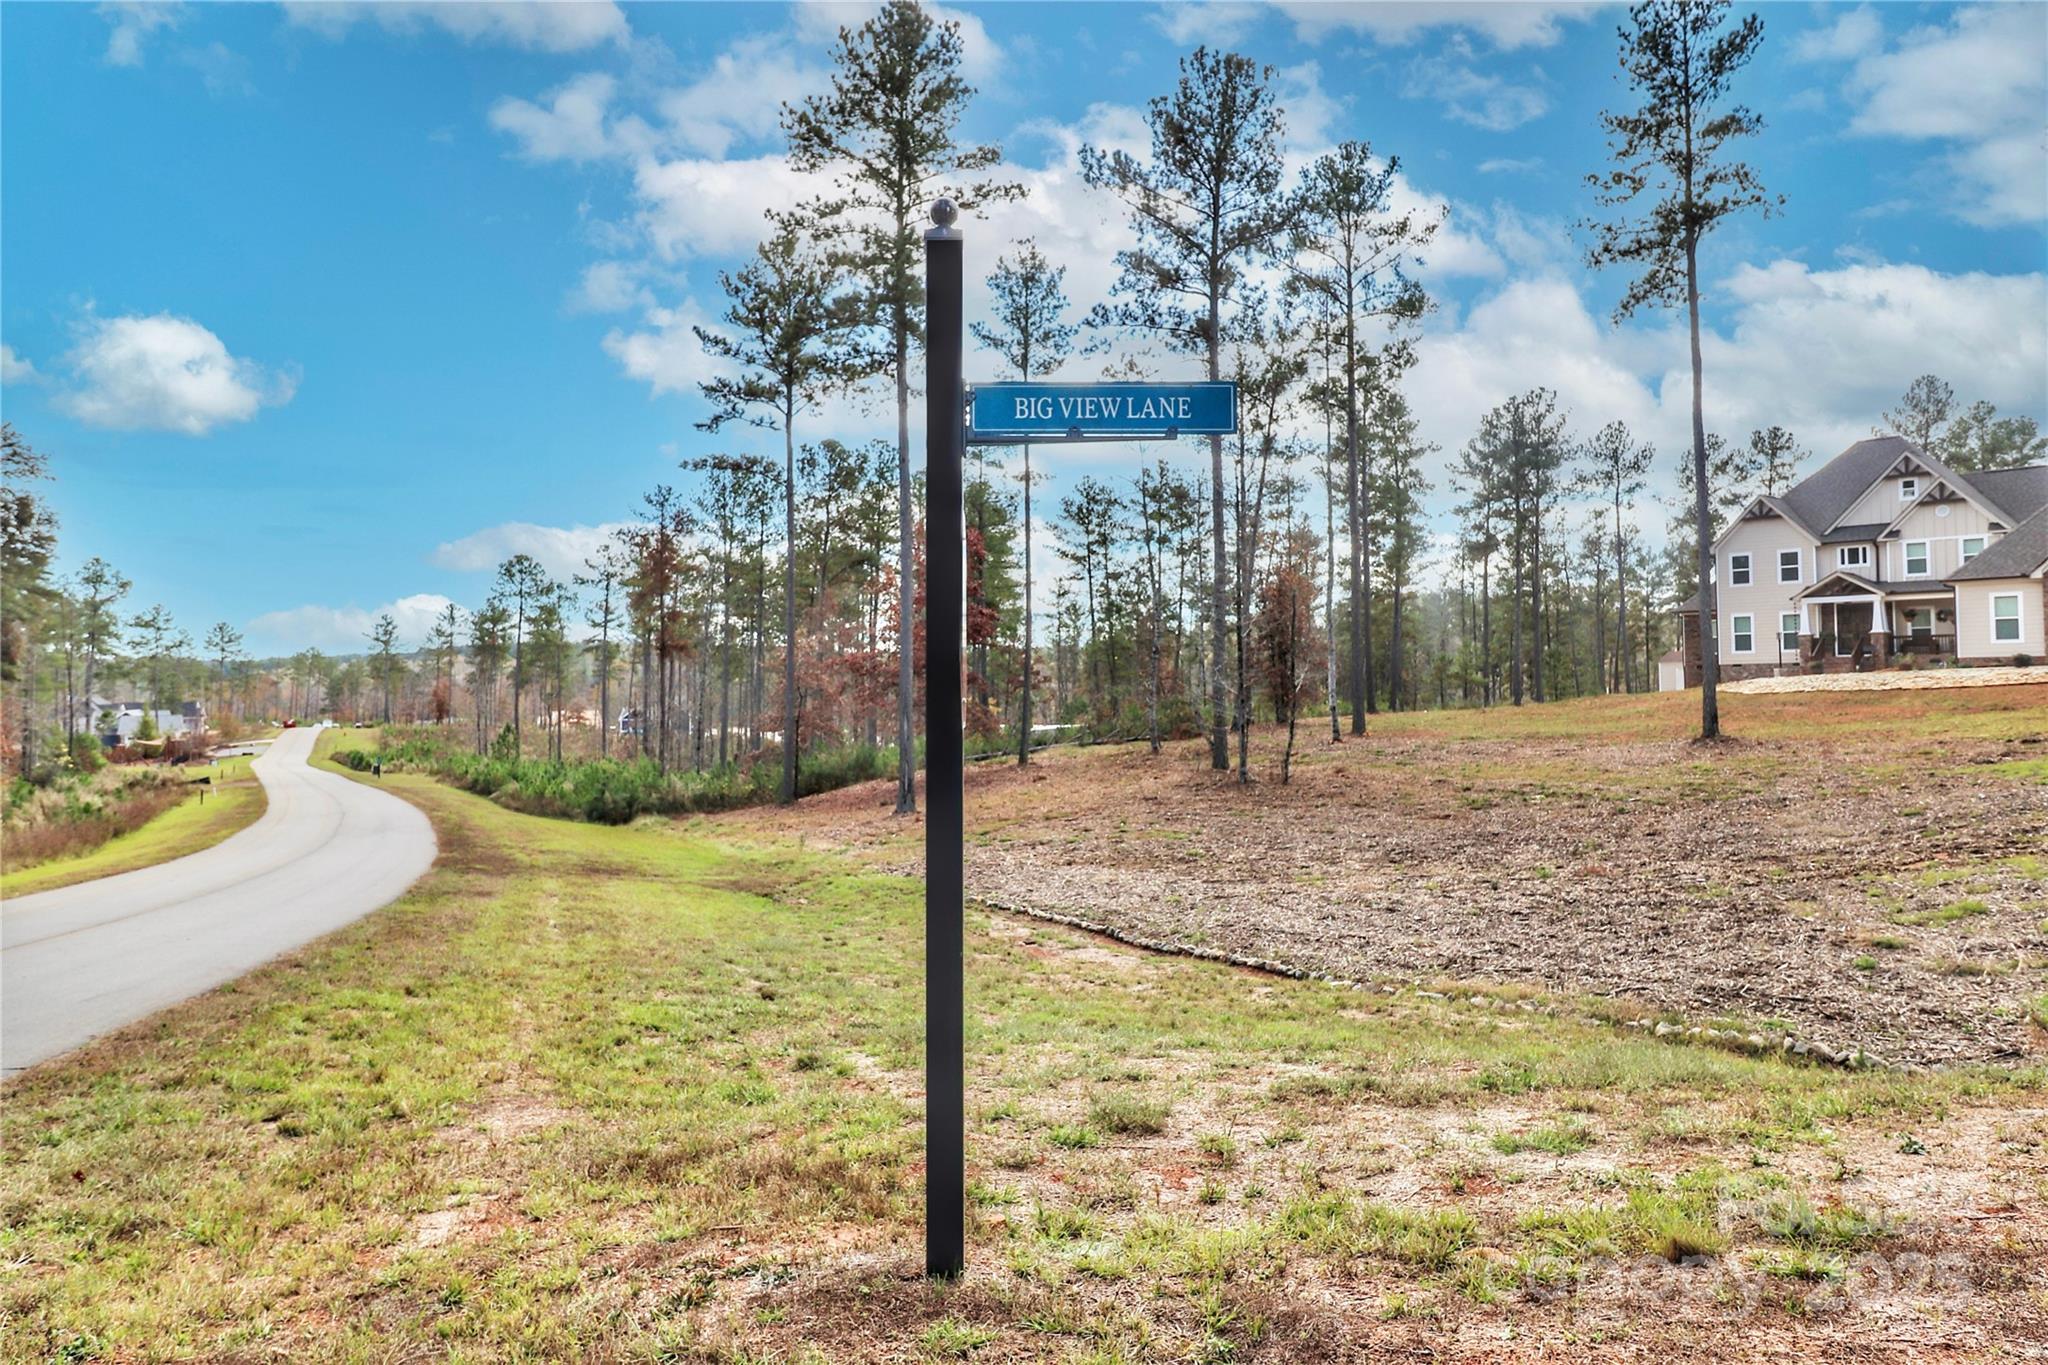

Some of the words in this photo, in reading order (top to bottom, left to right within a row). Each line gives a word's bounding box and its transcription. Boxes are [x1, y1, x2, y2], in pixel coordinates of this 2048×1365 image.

[1014, 397, 1053, 420] BIG
[1058, 397, 1121, 420] VIEW
[1127, 397, 1192, 420] LANE
